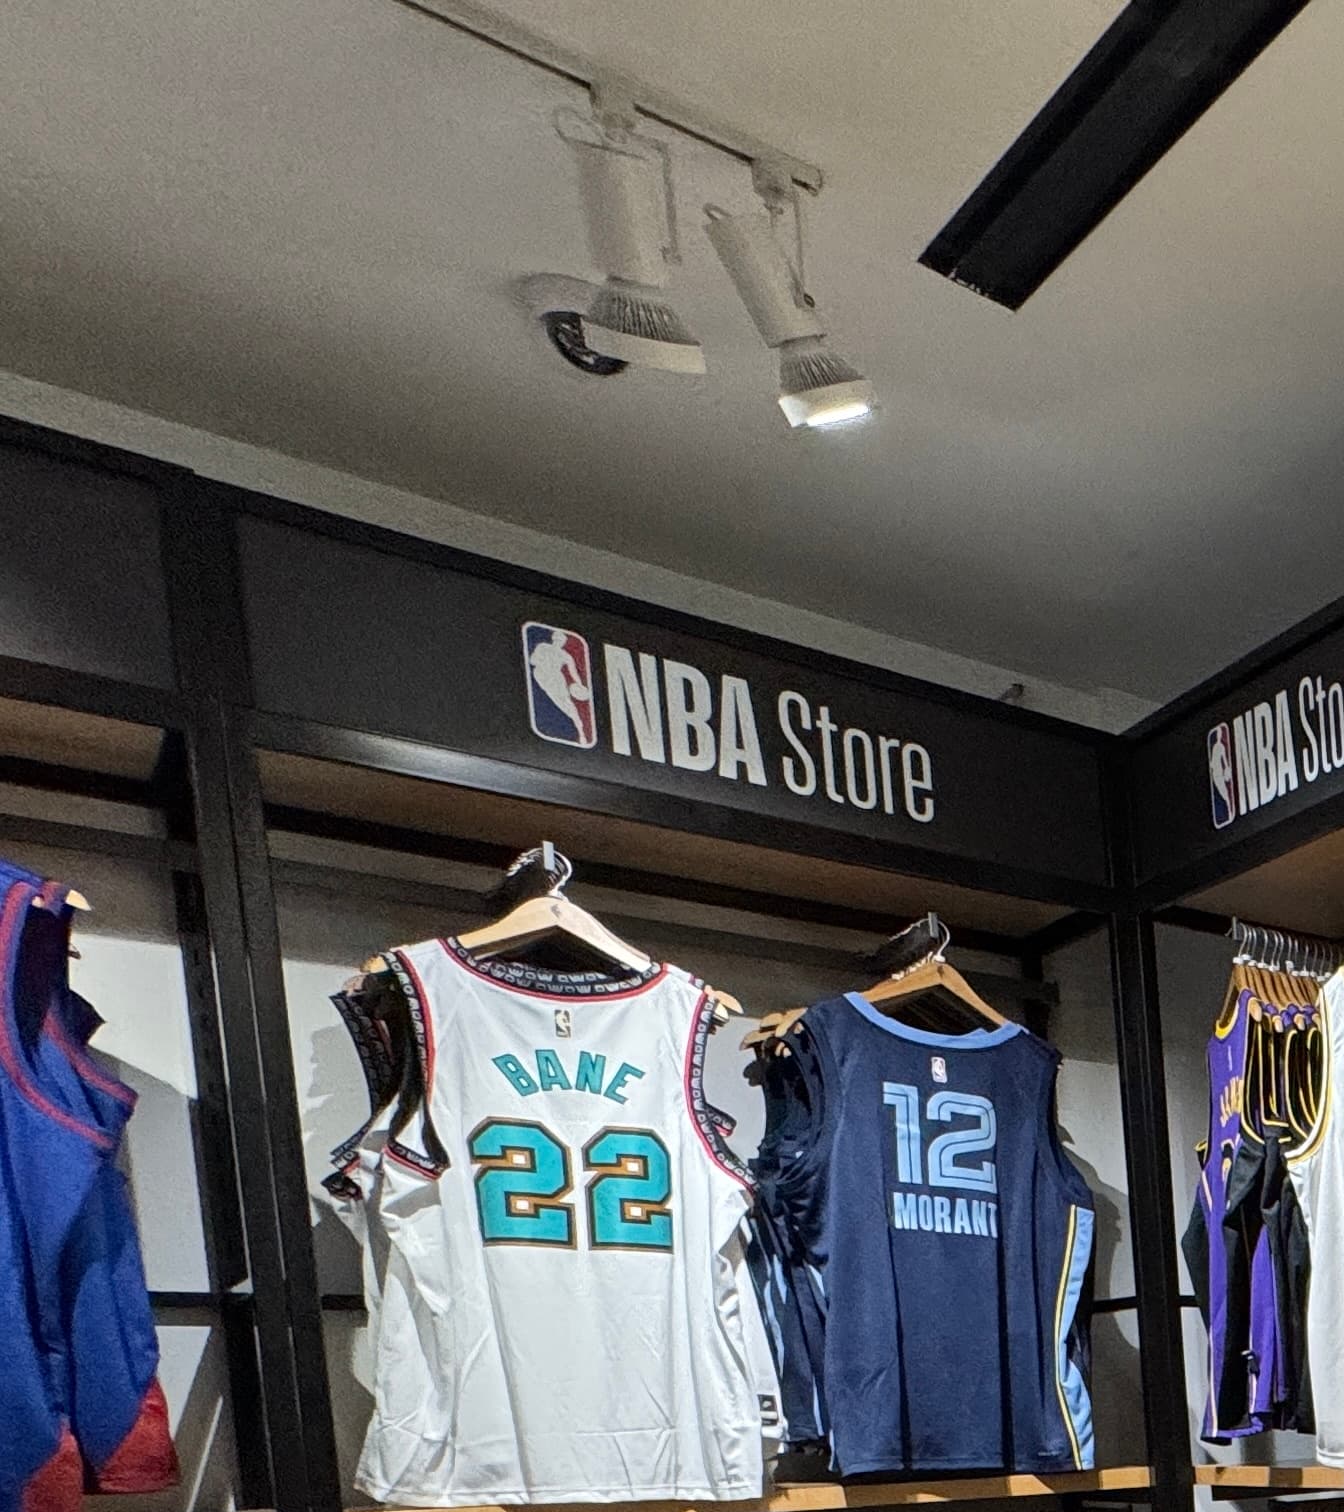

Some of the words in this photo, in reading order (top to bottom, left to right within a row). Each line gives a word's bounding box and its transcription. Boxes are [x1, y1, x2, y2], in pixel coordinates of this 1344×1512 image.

[603, 643, 768, 787] NBA
[778, 689, 935, 824] Store
[1233, 689, 1299, 816] NBA
[491, 1048, 646, 1105] BANE
[467, 1115, 674, 1254] 22
[882, 1080, 998, 1195] 12
[892, 1191, 999, 1239] MORANT
